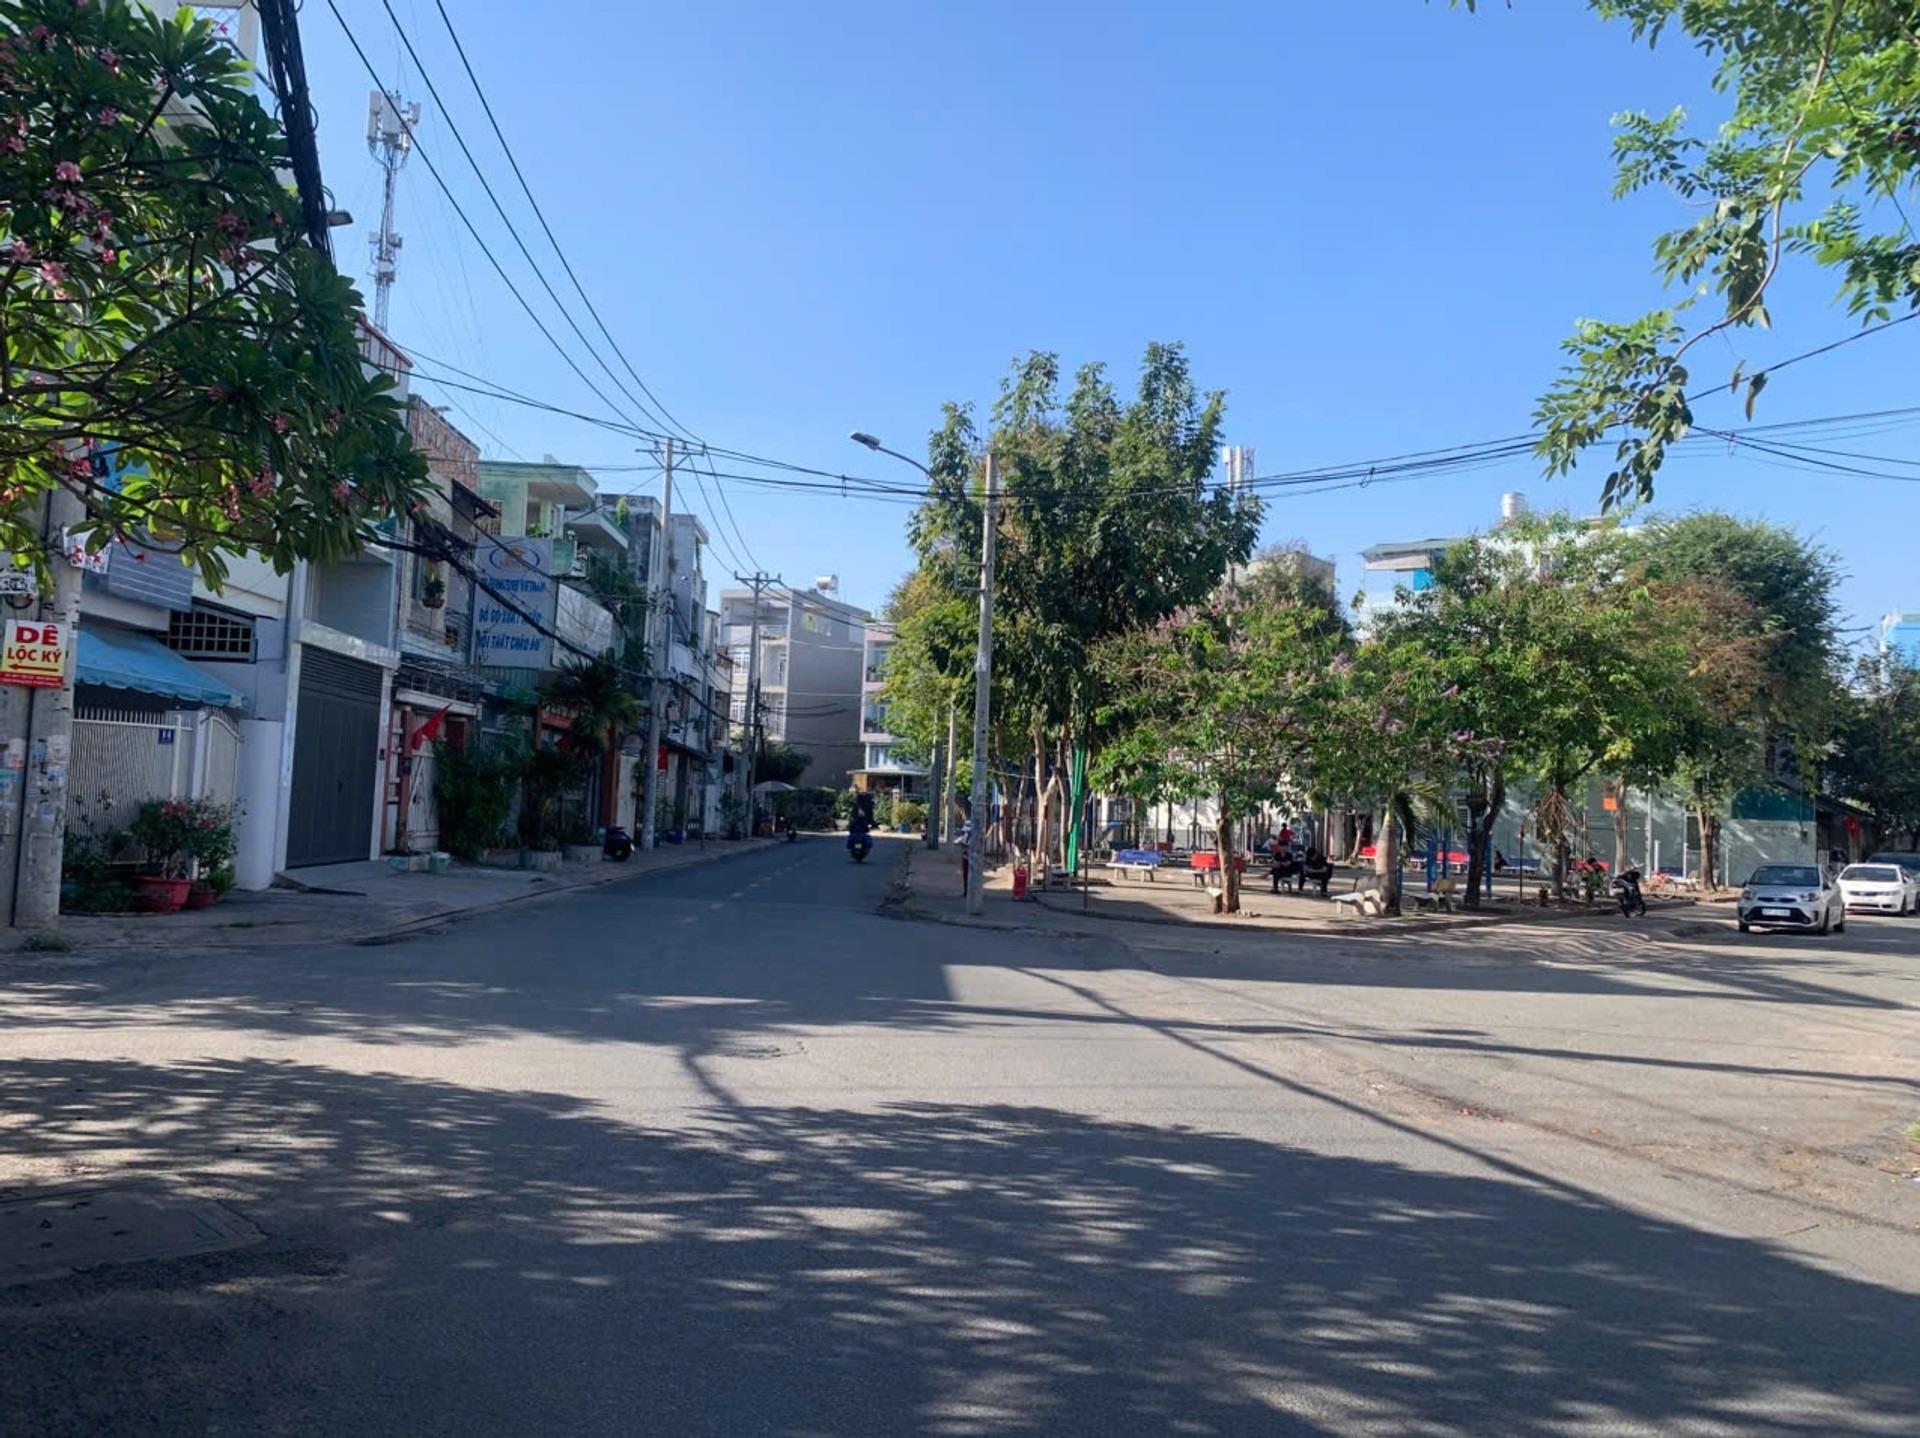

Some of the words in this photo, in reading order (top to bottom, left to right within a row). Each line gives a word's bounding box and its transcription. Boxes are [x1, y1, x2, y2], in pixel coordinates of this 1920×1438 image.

[16, 625, 58, 646] DÊ
[7, 645, 37, 663] LỘC
[42, 648, 61, 663] KÝ
